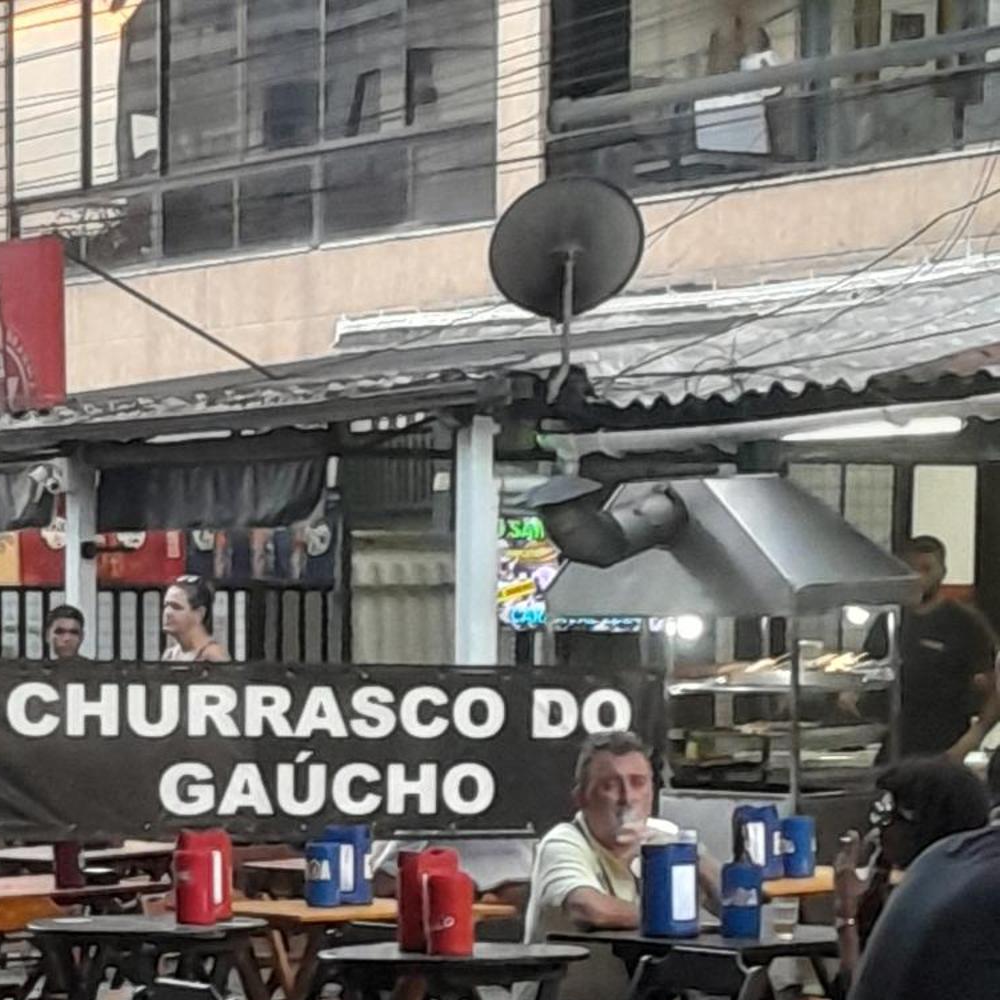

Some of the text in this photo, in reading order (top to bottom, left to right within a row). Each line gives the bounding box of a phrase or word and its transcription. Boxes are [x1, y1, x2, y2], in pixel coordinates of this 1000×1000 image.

[6, 682, 631, 739] CHURRASCO DO
[159, 751, 495, 816] GAÚCHO
